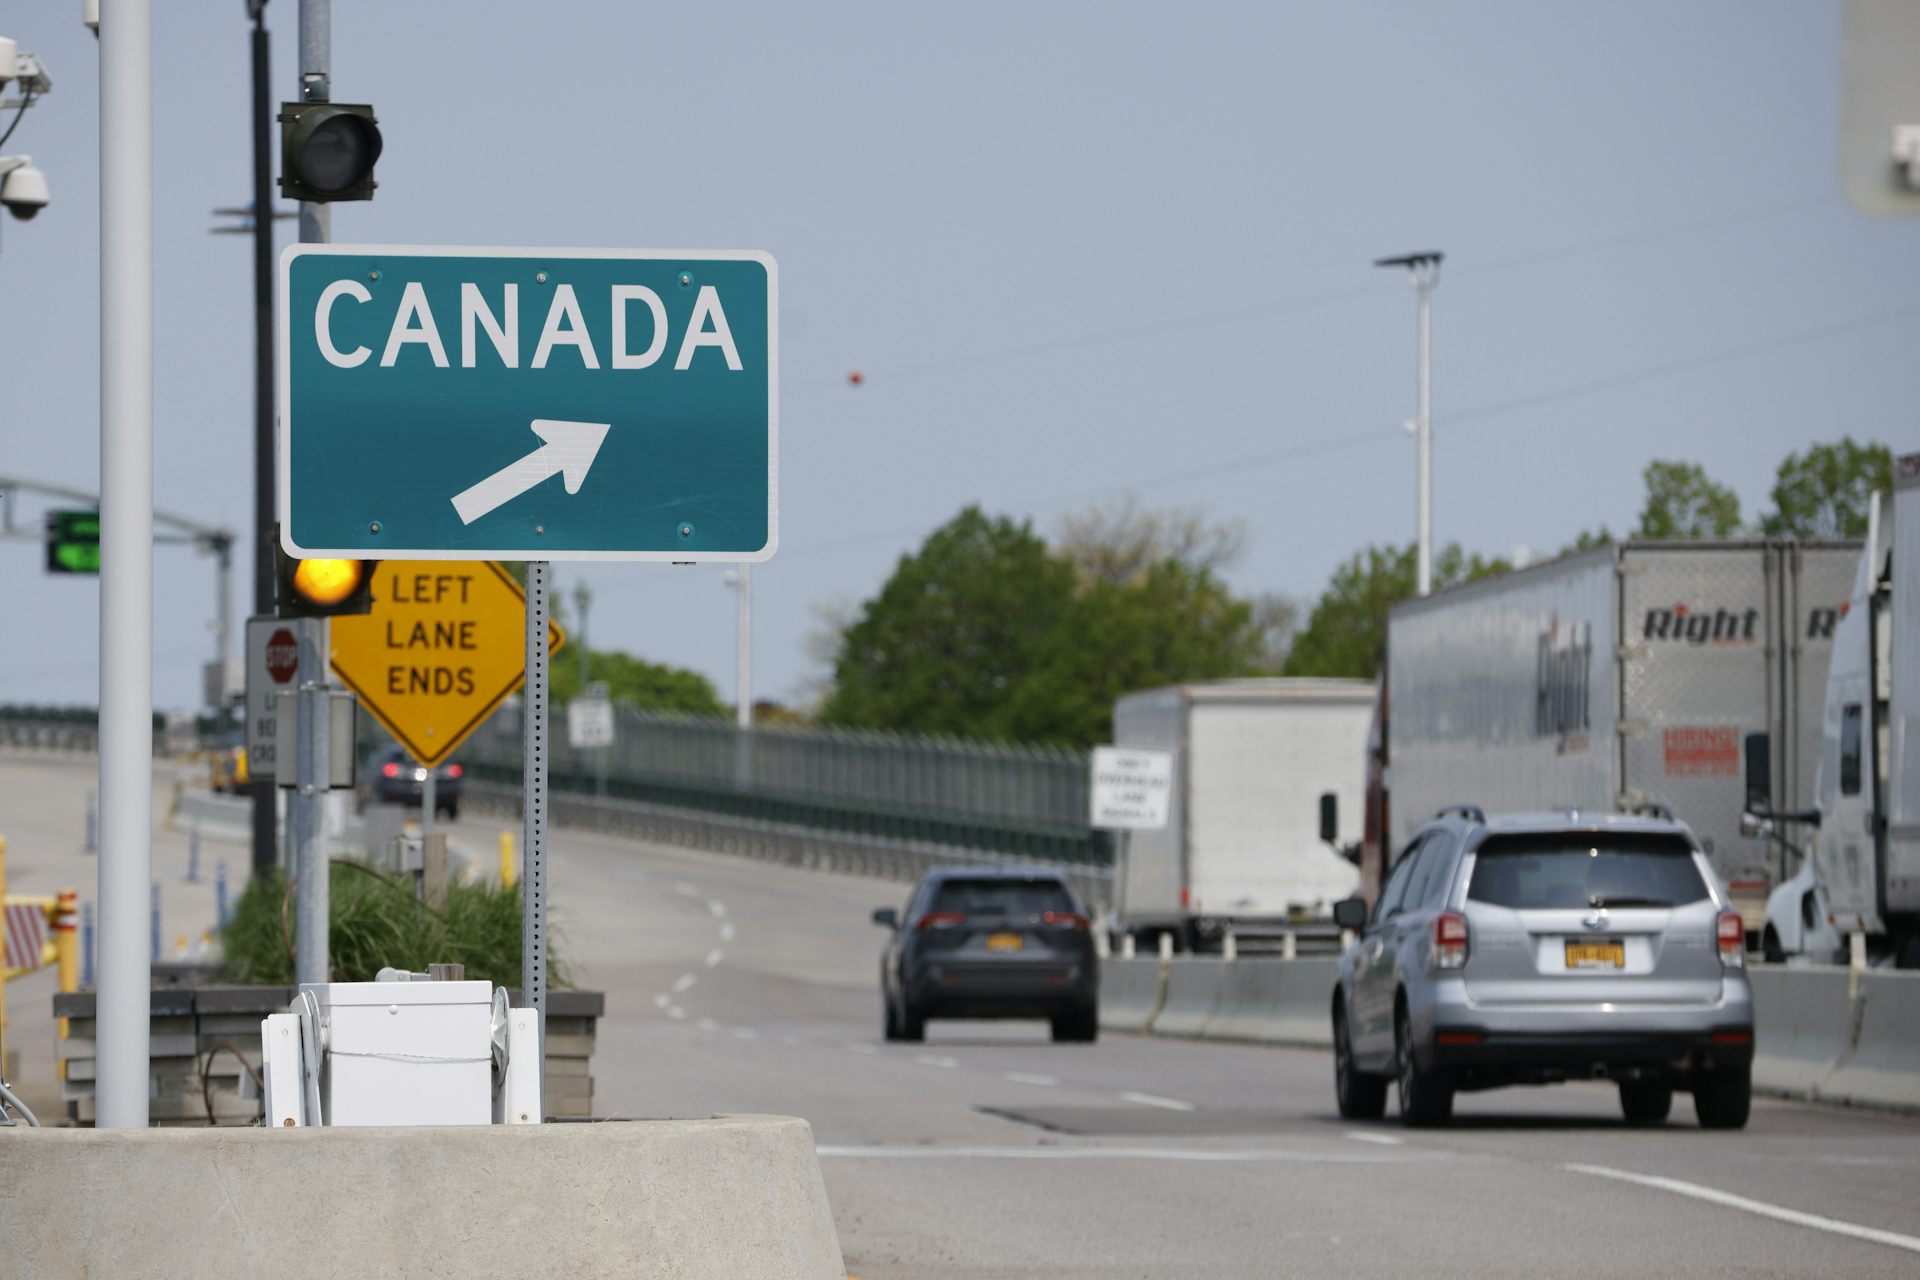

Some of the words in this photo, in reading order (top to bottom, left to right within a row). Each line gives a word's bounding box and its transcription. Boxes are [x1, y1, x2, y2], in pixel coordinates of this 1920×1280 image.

[314, 279, 744, 371] CANADA
[392, 575, 474, 604] LEFT
[387, 620, 477, 650] LANE
[1643, 602, 1758, 646] Right
[266, 645, 298, 669] STOP
[388, 666, 475, 697] ENDS
